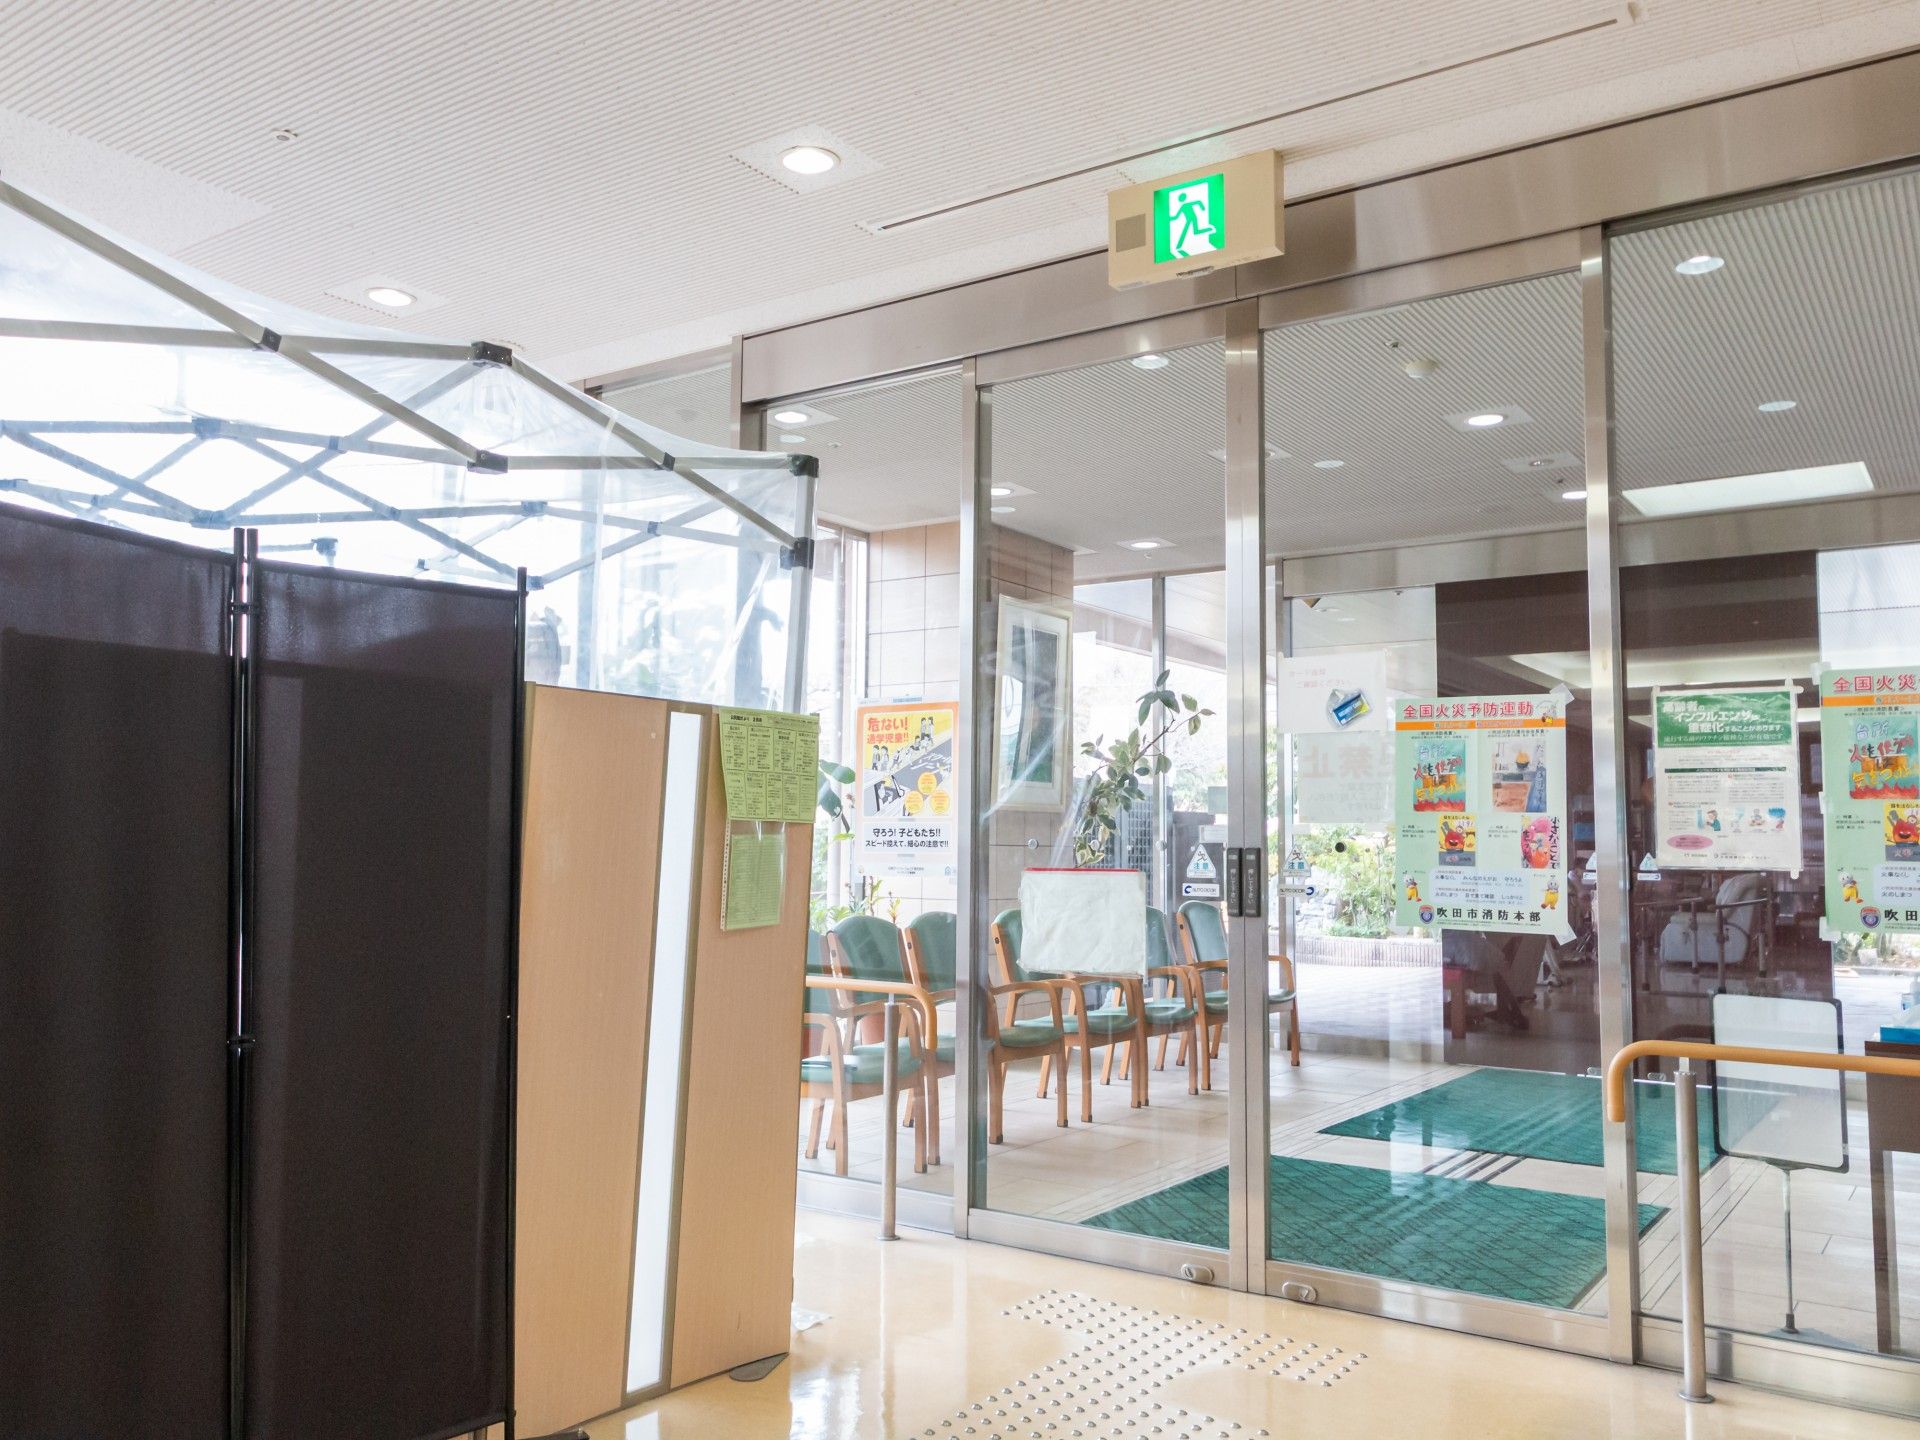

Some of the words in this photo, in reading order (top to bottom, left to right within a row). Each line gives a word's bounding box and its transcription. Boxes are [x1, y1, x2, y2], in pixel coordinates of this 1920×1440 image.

[1834, 674, 1920, 693] 全国火災
[1404, 701, 1533, 719] 全国火災予防運動
[867, 716, 908, 732] 危ない!
[873, 828, 897, 838] 守ろう!
[899, 828, 941, 838] 子どもたち!!
[1437, 907, 1541, 922] 吹田市消防本部
[1884, 909, 1918, 921] 吹田
